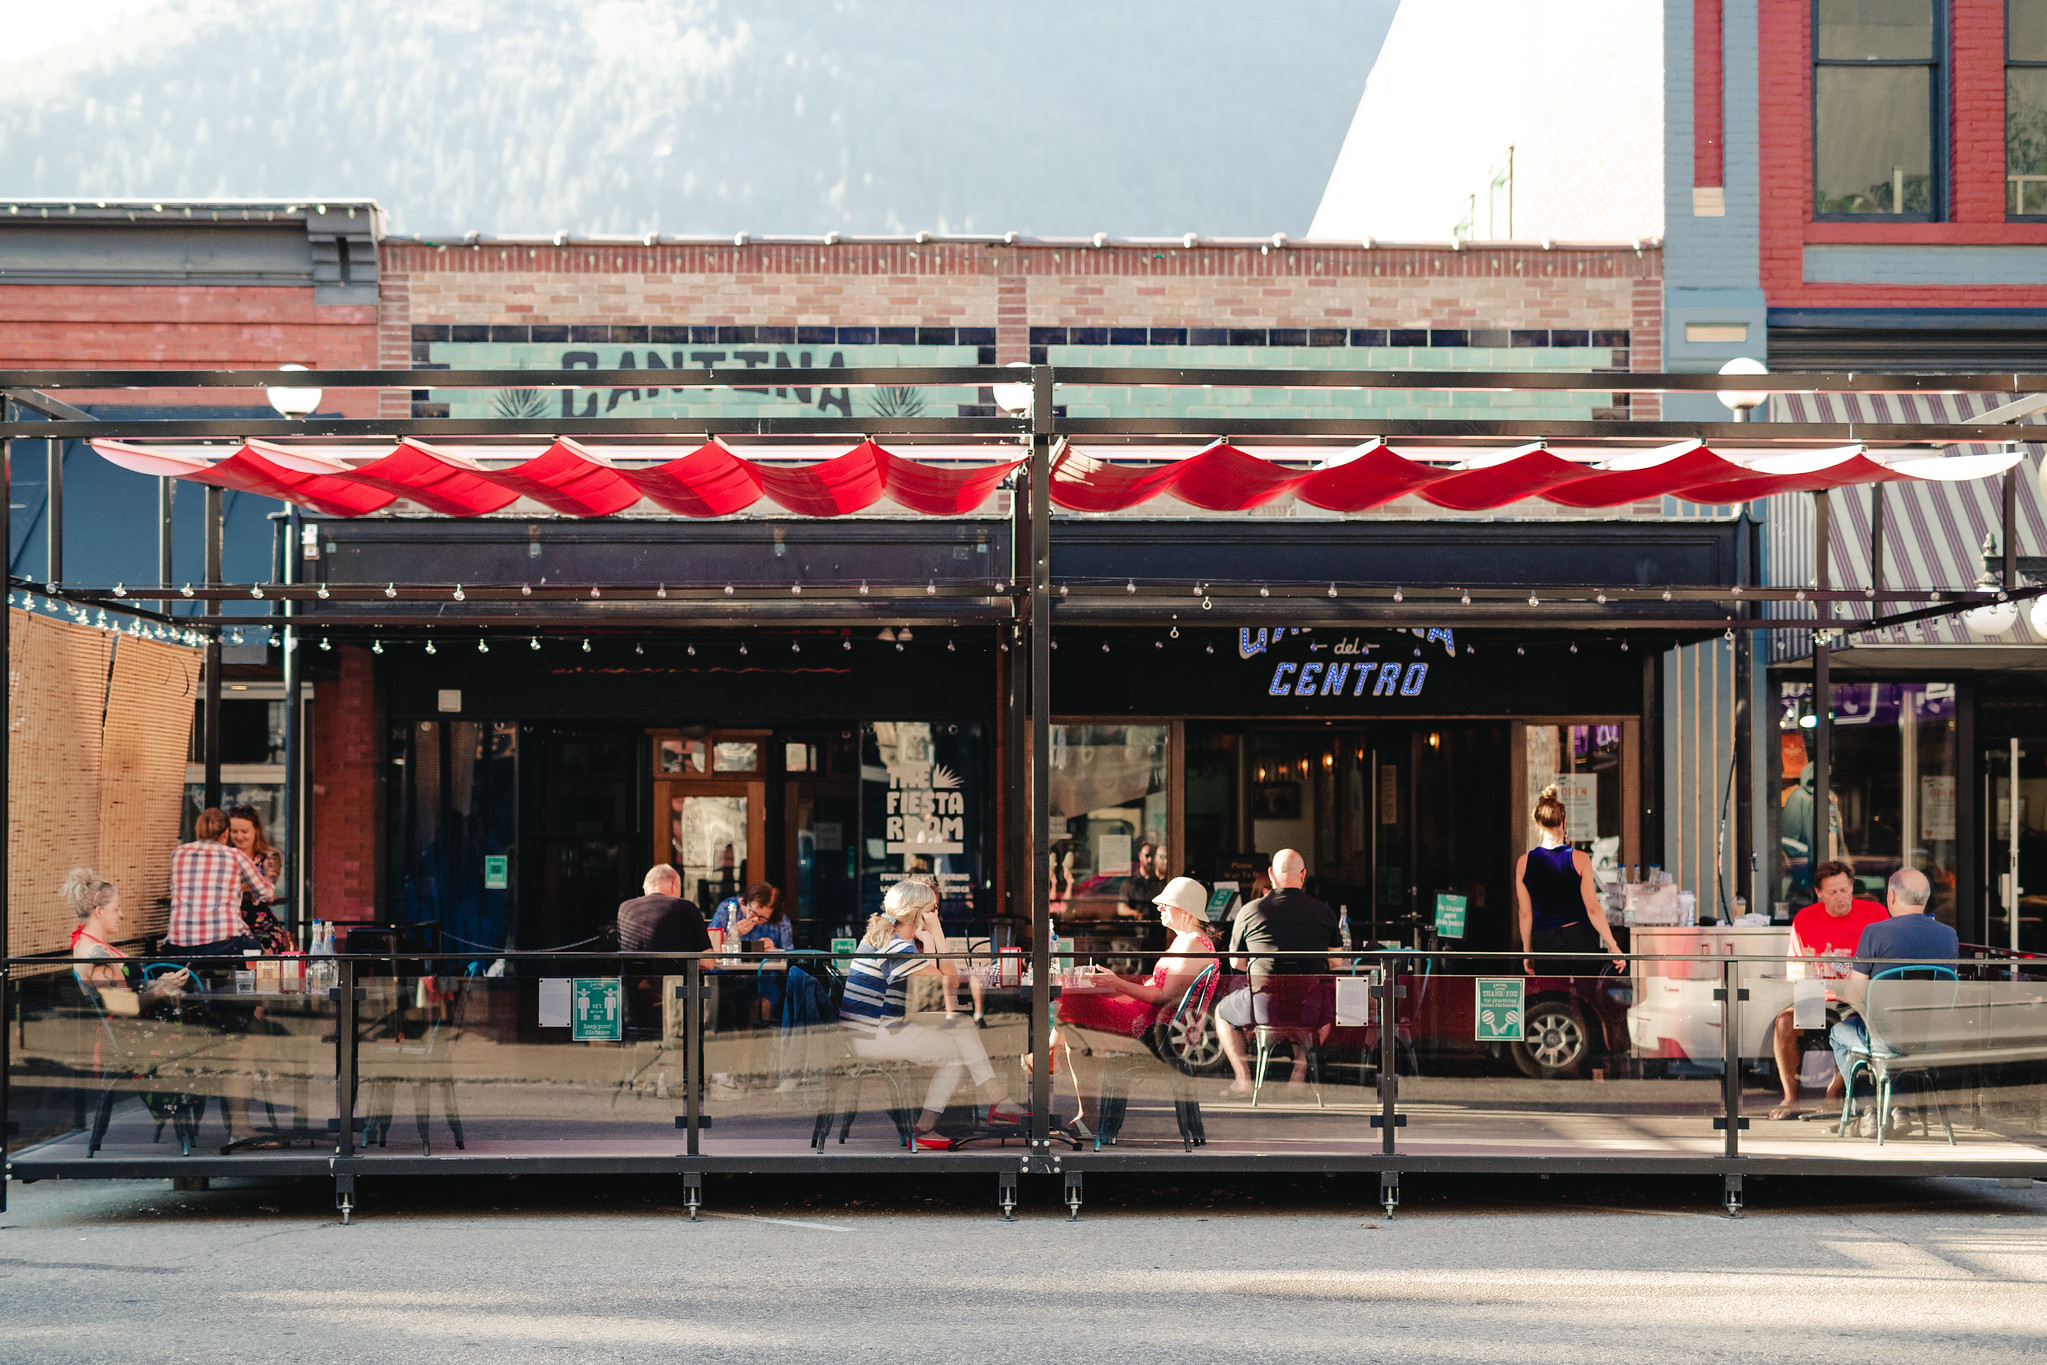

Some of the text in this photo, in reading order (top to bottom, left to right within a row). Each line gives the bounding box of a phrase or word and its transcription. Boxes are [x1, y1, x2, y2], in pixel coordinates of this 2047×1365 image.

[562, 351, 853, 418] CANTINA
[1334, 637, 1361, 655] del
[1268, 662, 1429, 696] CENTRO
[887, 766, 931, 789] THE
[886, 791, 964, 815] FIESTA
